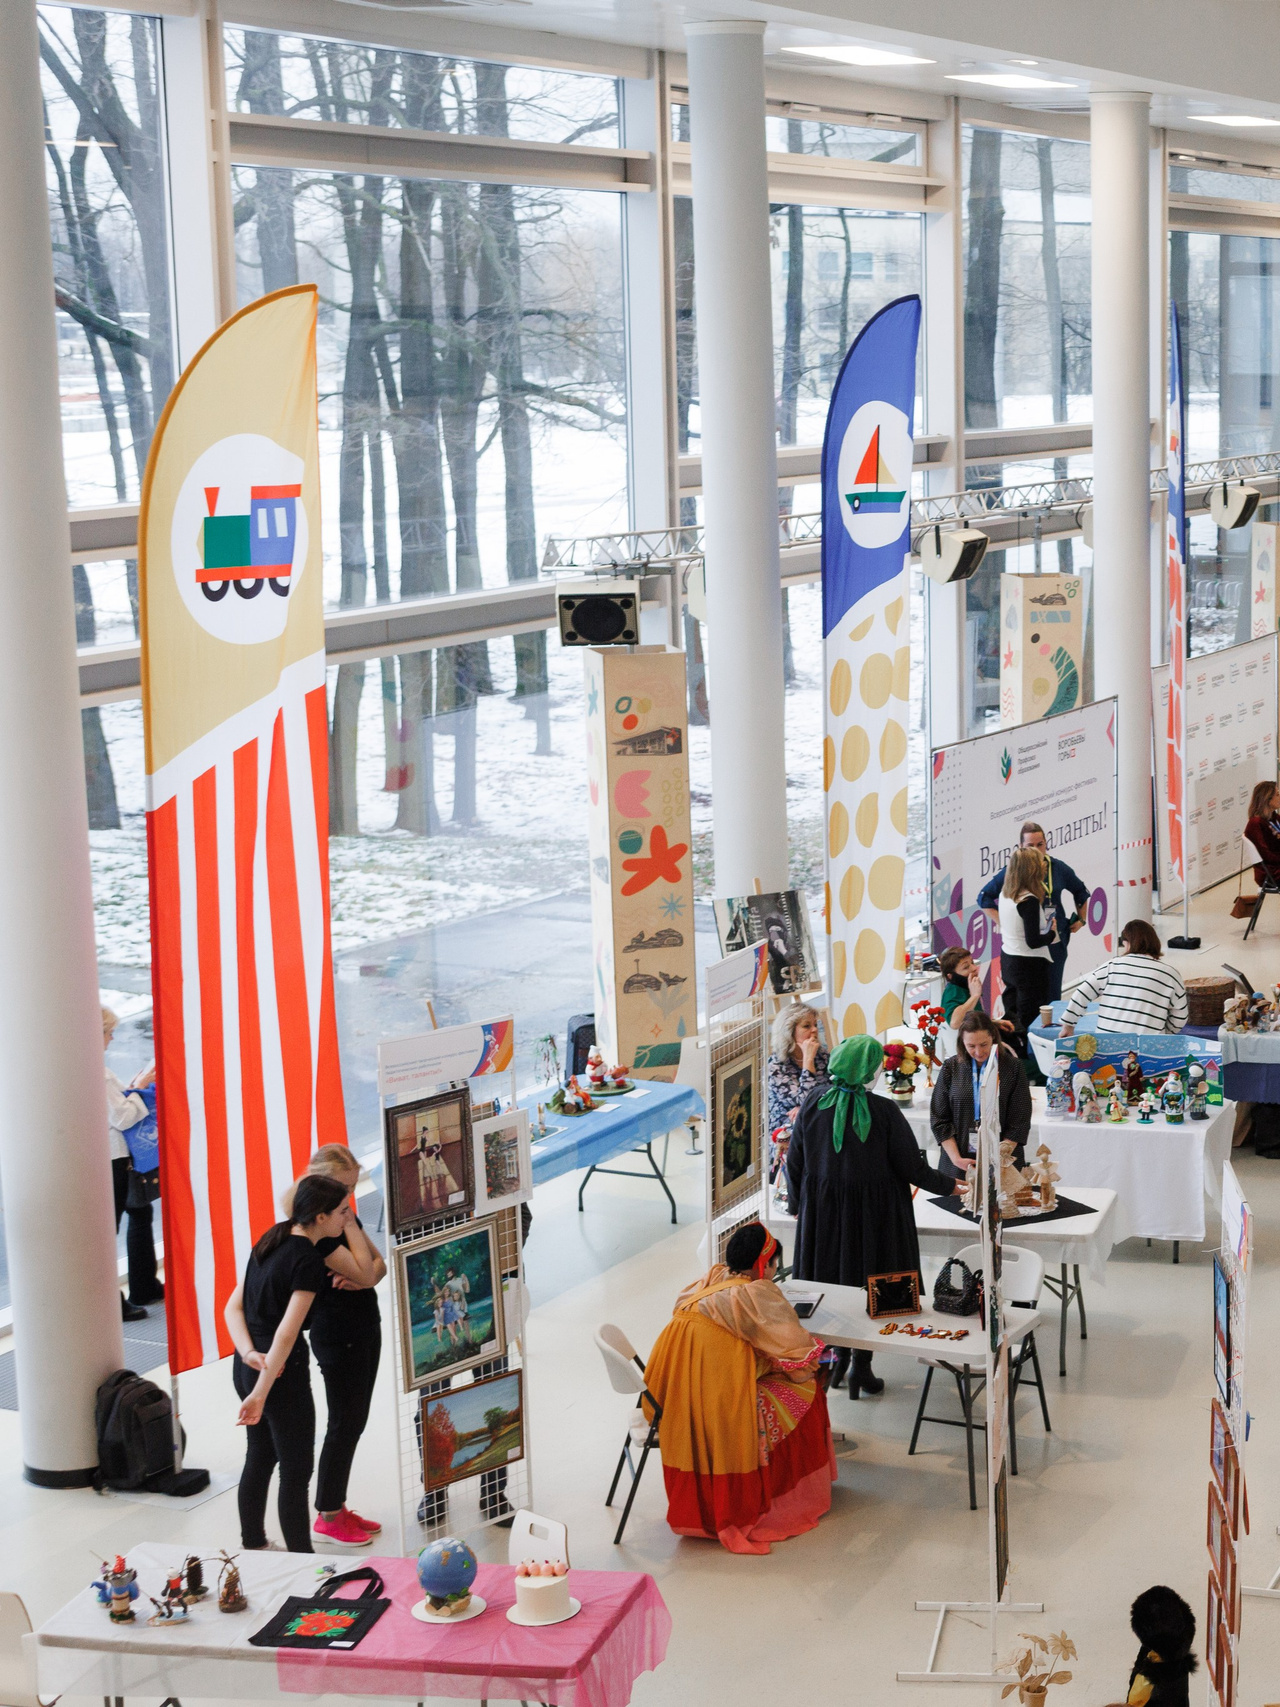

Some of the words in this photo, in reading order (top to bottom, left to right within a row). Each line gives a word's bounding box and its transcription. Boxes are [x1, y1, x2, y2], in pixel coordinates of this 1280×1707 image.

[990, 801, 1028, 820] Всероссийский
[1028, 790, 1055, 806] творческий
[1051, 795, 1078, 812] работников
[1045, 800, 1107, 851] аланты!
